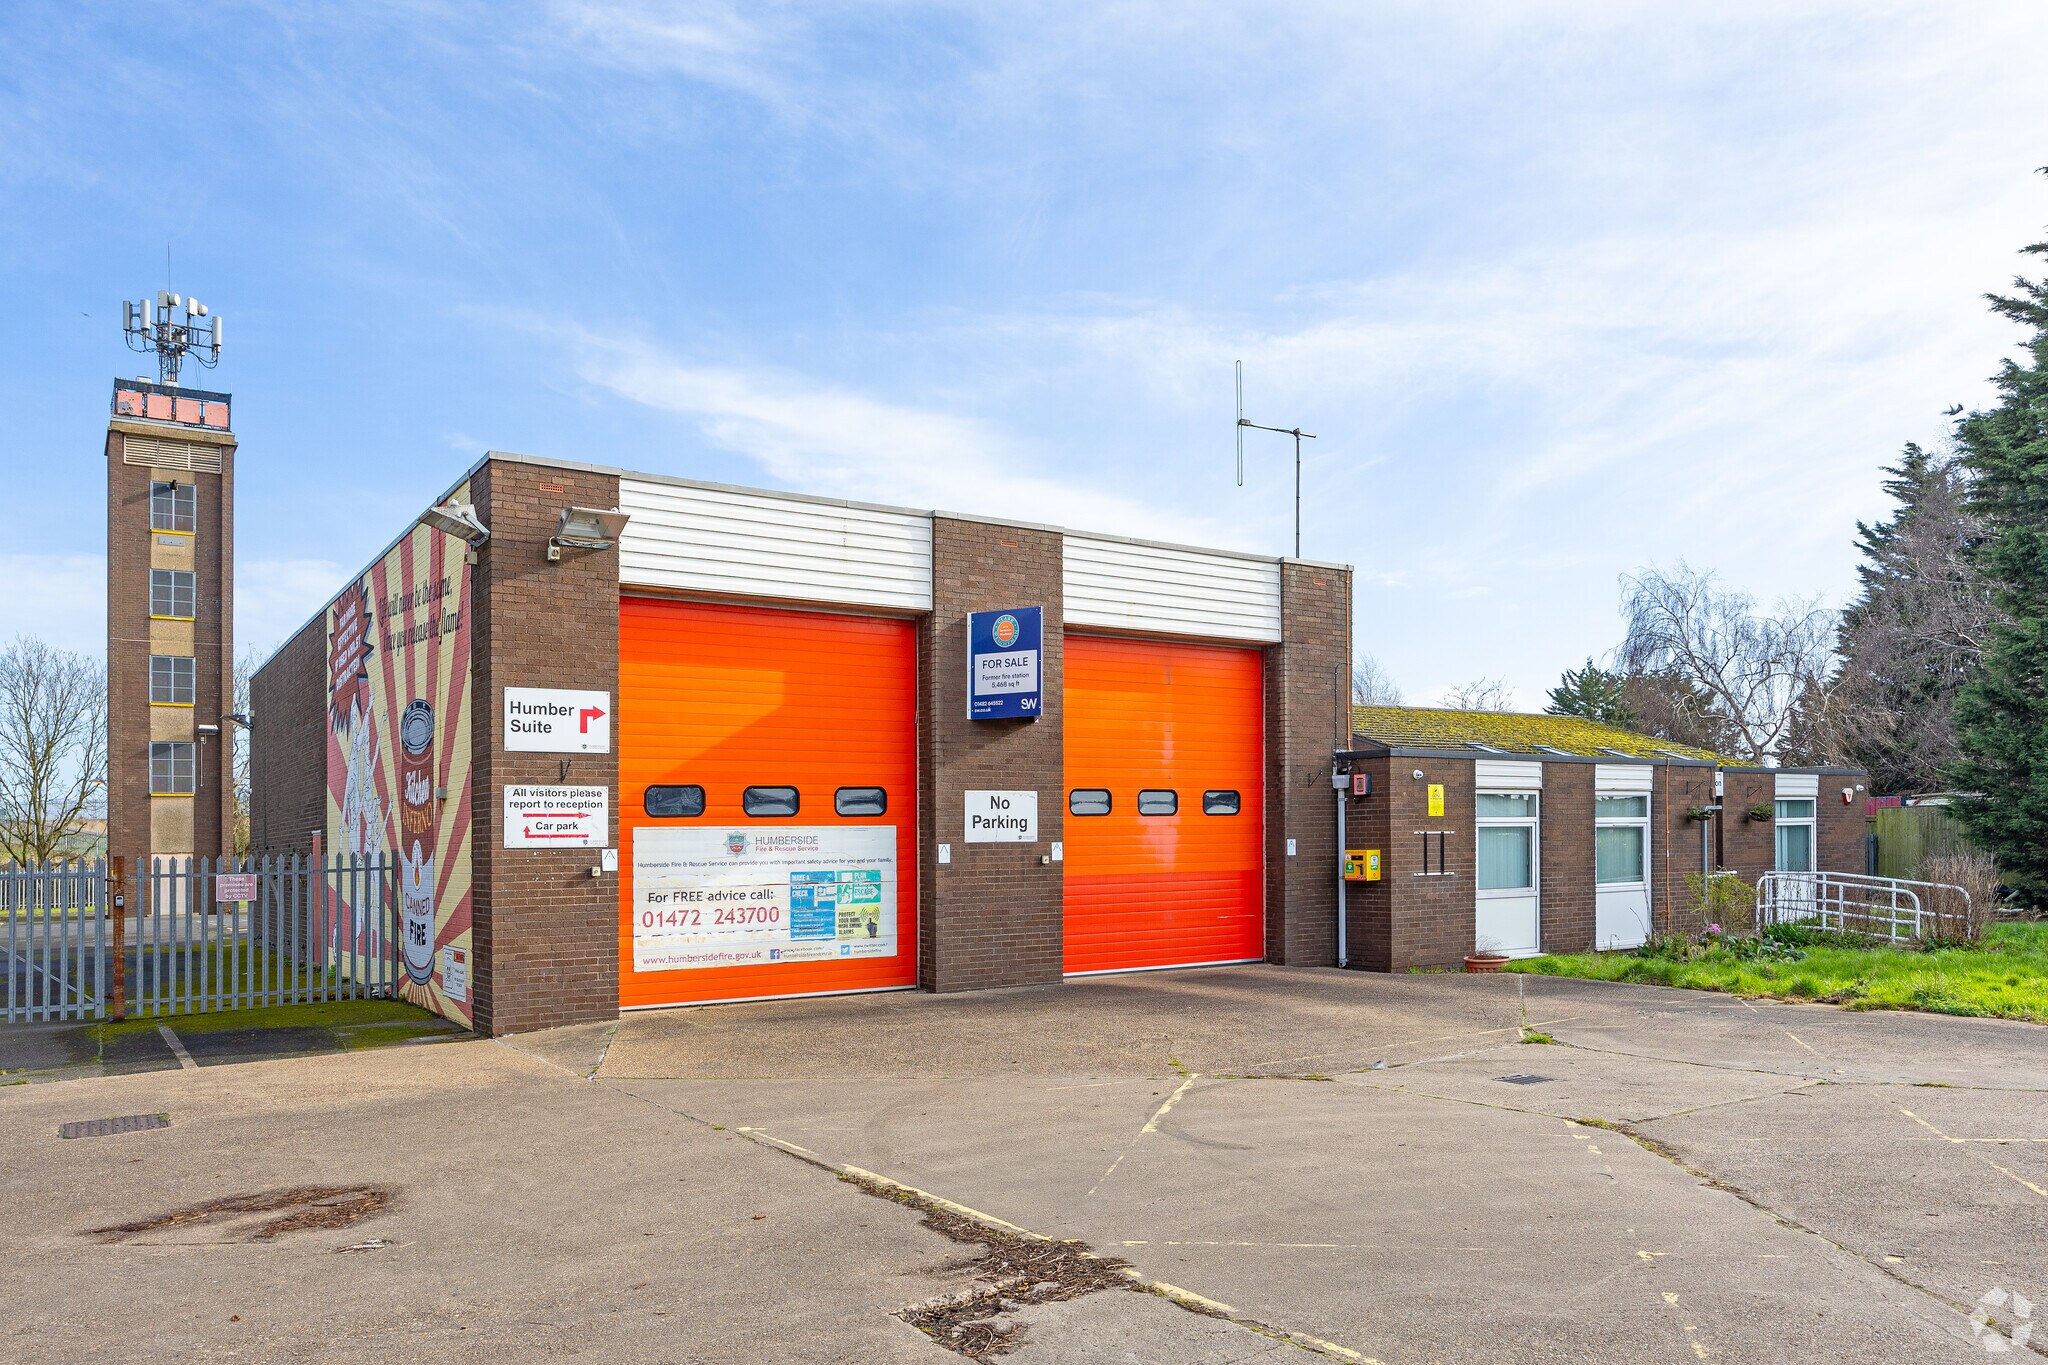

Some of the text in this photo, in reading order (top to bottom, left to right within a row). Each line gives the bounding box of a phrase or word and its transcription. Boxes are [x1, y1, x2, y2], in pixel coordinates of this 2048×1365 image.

[982, 657, 1028, 670] FOR SALE
[510, 700, 574, 716] Humber
[1021, 698, 1038, 710] SW
[510, 719, 552, 734] Suite
[405, 770, 430, 806] Kitchen
[512, 788, 602, 799] All visitors please
[509, 800, 542, 810] report
[556, 801, 603, 810] reception
[990, 796, 1010, 810] No
[403, 802, 432, 834] INFERNO
[972, 815, 1028, 832] Parking
[536, 822, 578, 832] Car park
[756, 836, 818, 846] HUMBERSIDE
[648, 889, 774, 903] For FREE advice call:
[405, 892, 430, 917] CANNED
[642, 909, 702, 928] 01472
[714, 906, 780, 925] 243700
[410, 918, 426, 946] FIRE
[642, 950, 762, 965] www.humbersidefire.gov.uk
